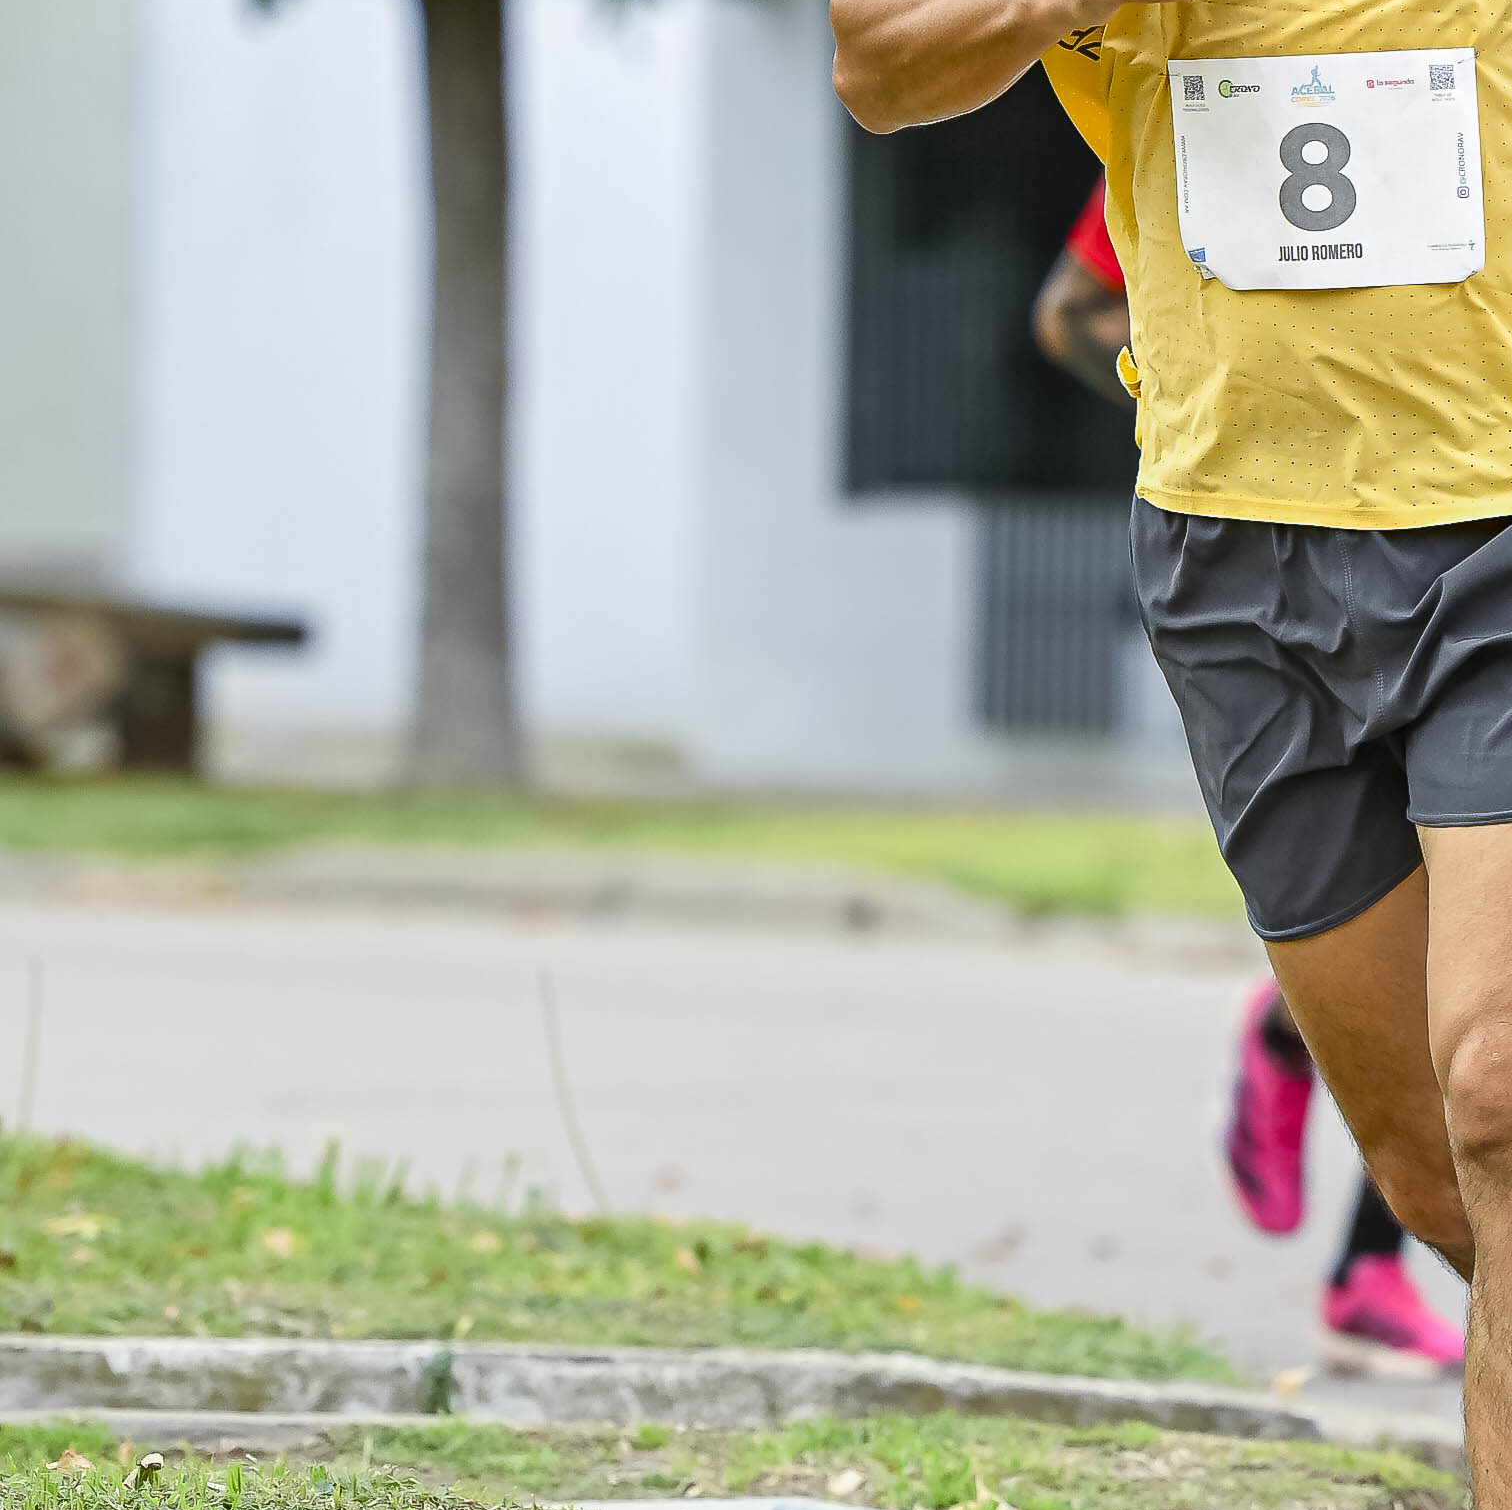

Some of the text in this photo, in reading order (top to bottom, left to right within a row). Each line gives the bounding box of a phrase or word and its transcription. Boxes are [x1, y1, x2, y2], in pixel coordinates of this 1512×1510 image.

[1279, 122, 1357, 232] 8
[1278, 242, 1363, 262] JULIO ROMERO
